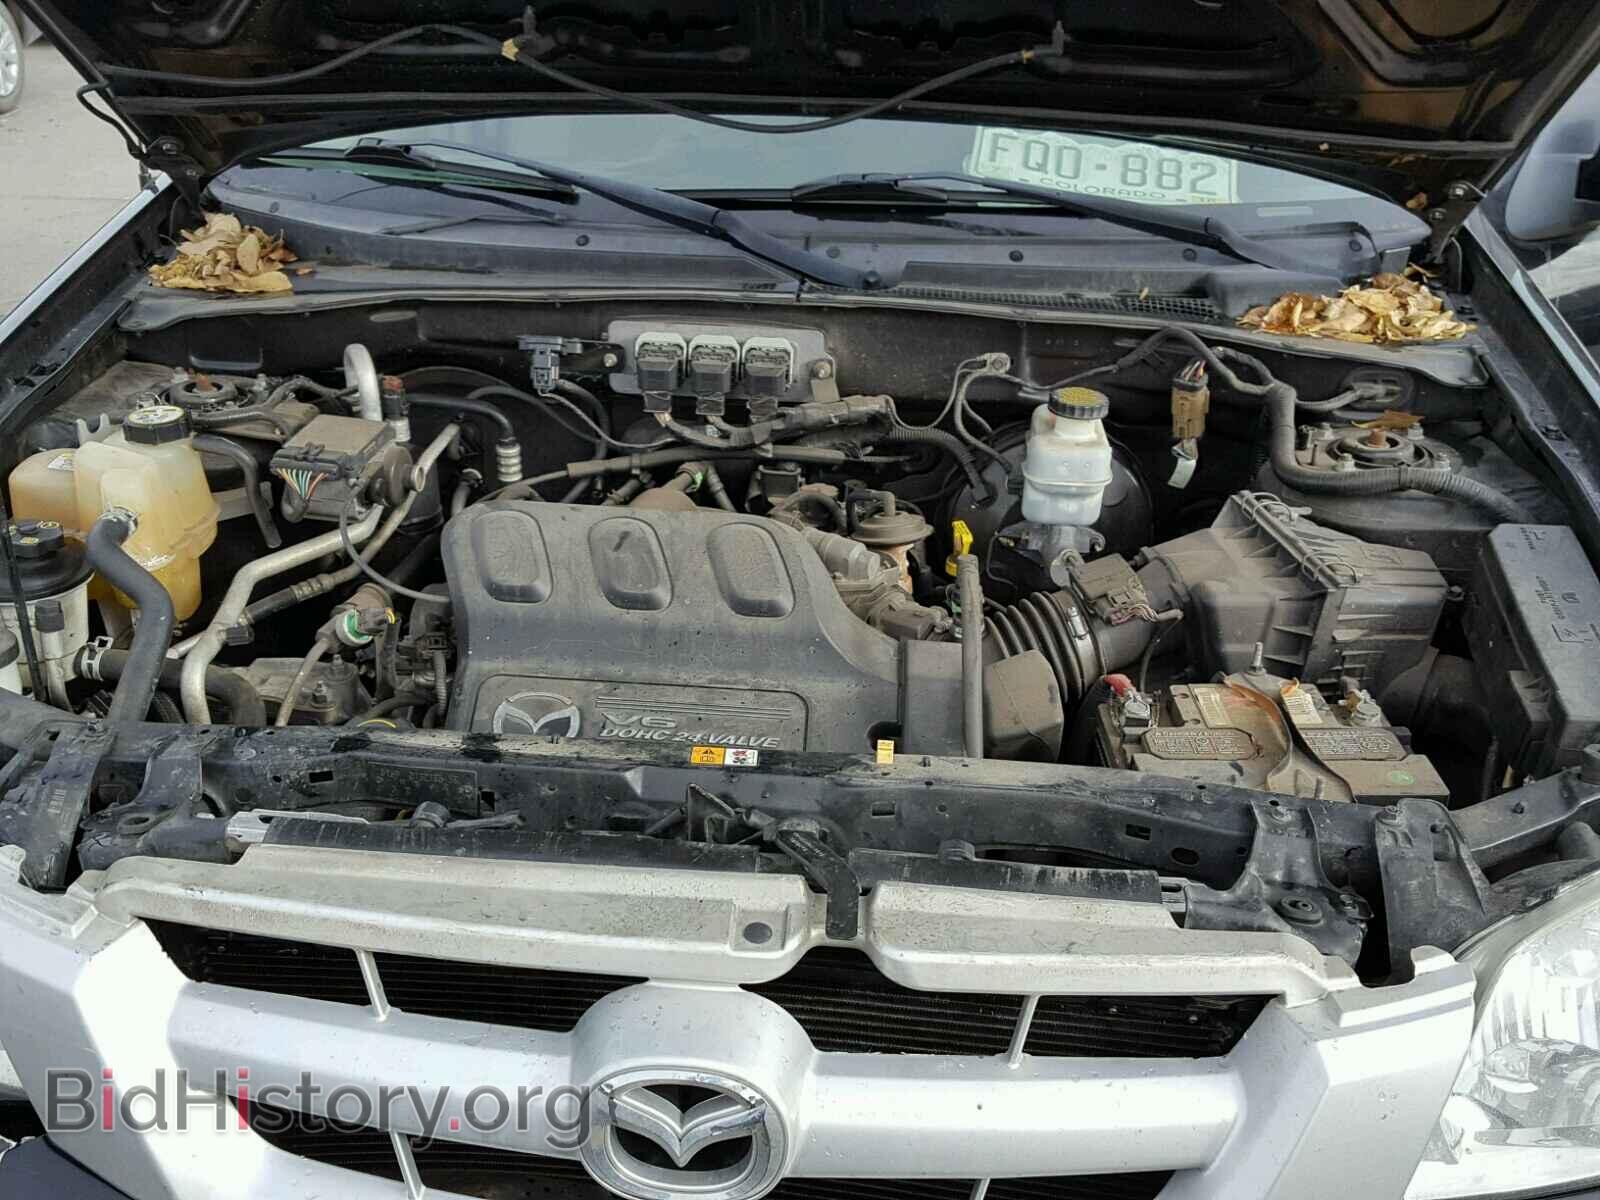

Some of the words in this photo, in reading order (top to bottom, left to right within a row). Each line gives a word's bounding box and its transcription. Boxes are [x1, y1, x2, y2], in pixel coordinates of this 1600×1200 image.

[1040, 178, 1167, 199] COLORADO
[601, 712, 677, 729] V6
[599, 728, 672, 741] DOHC
